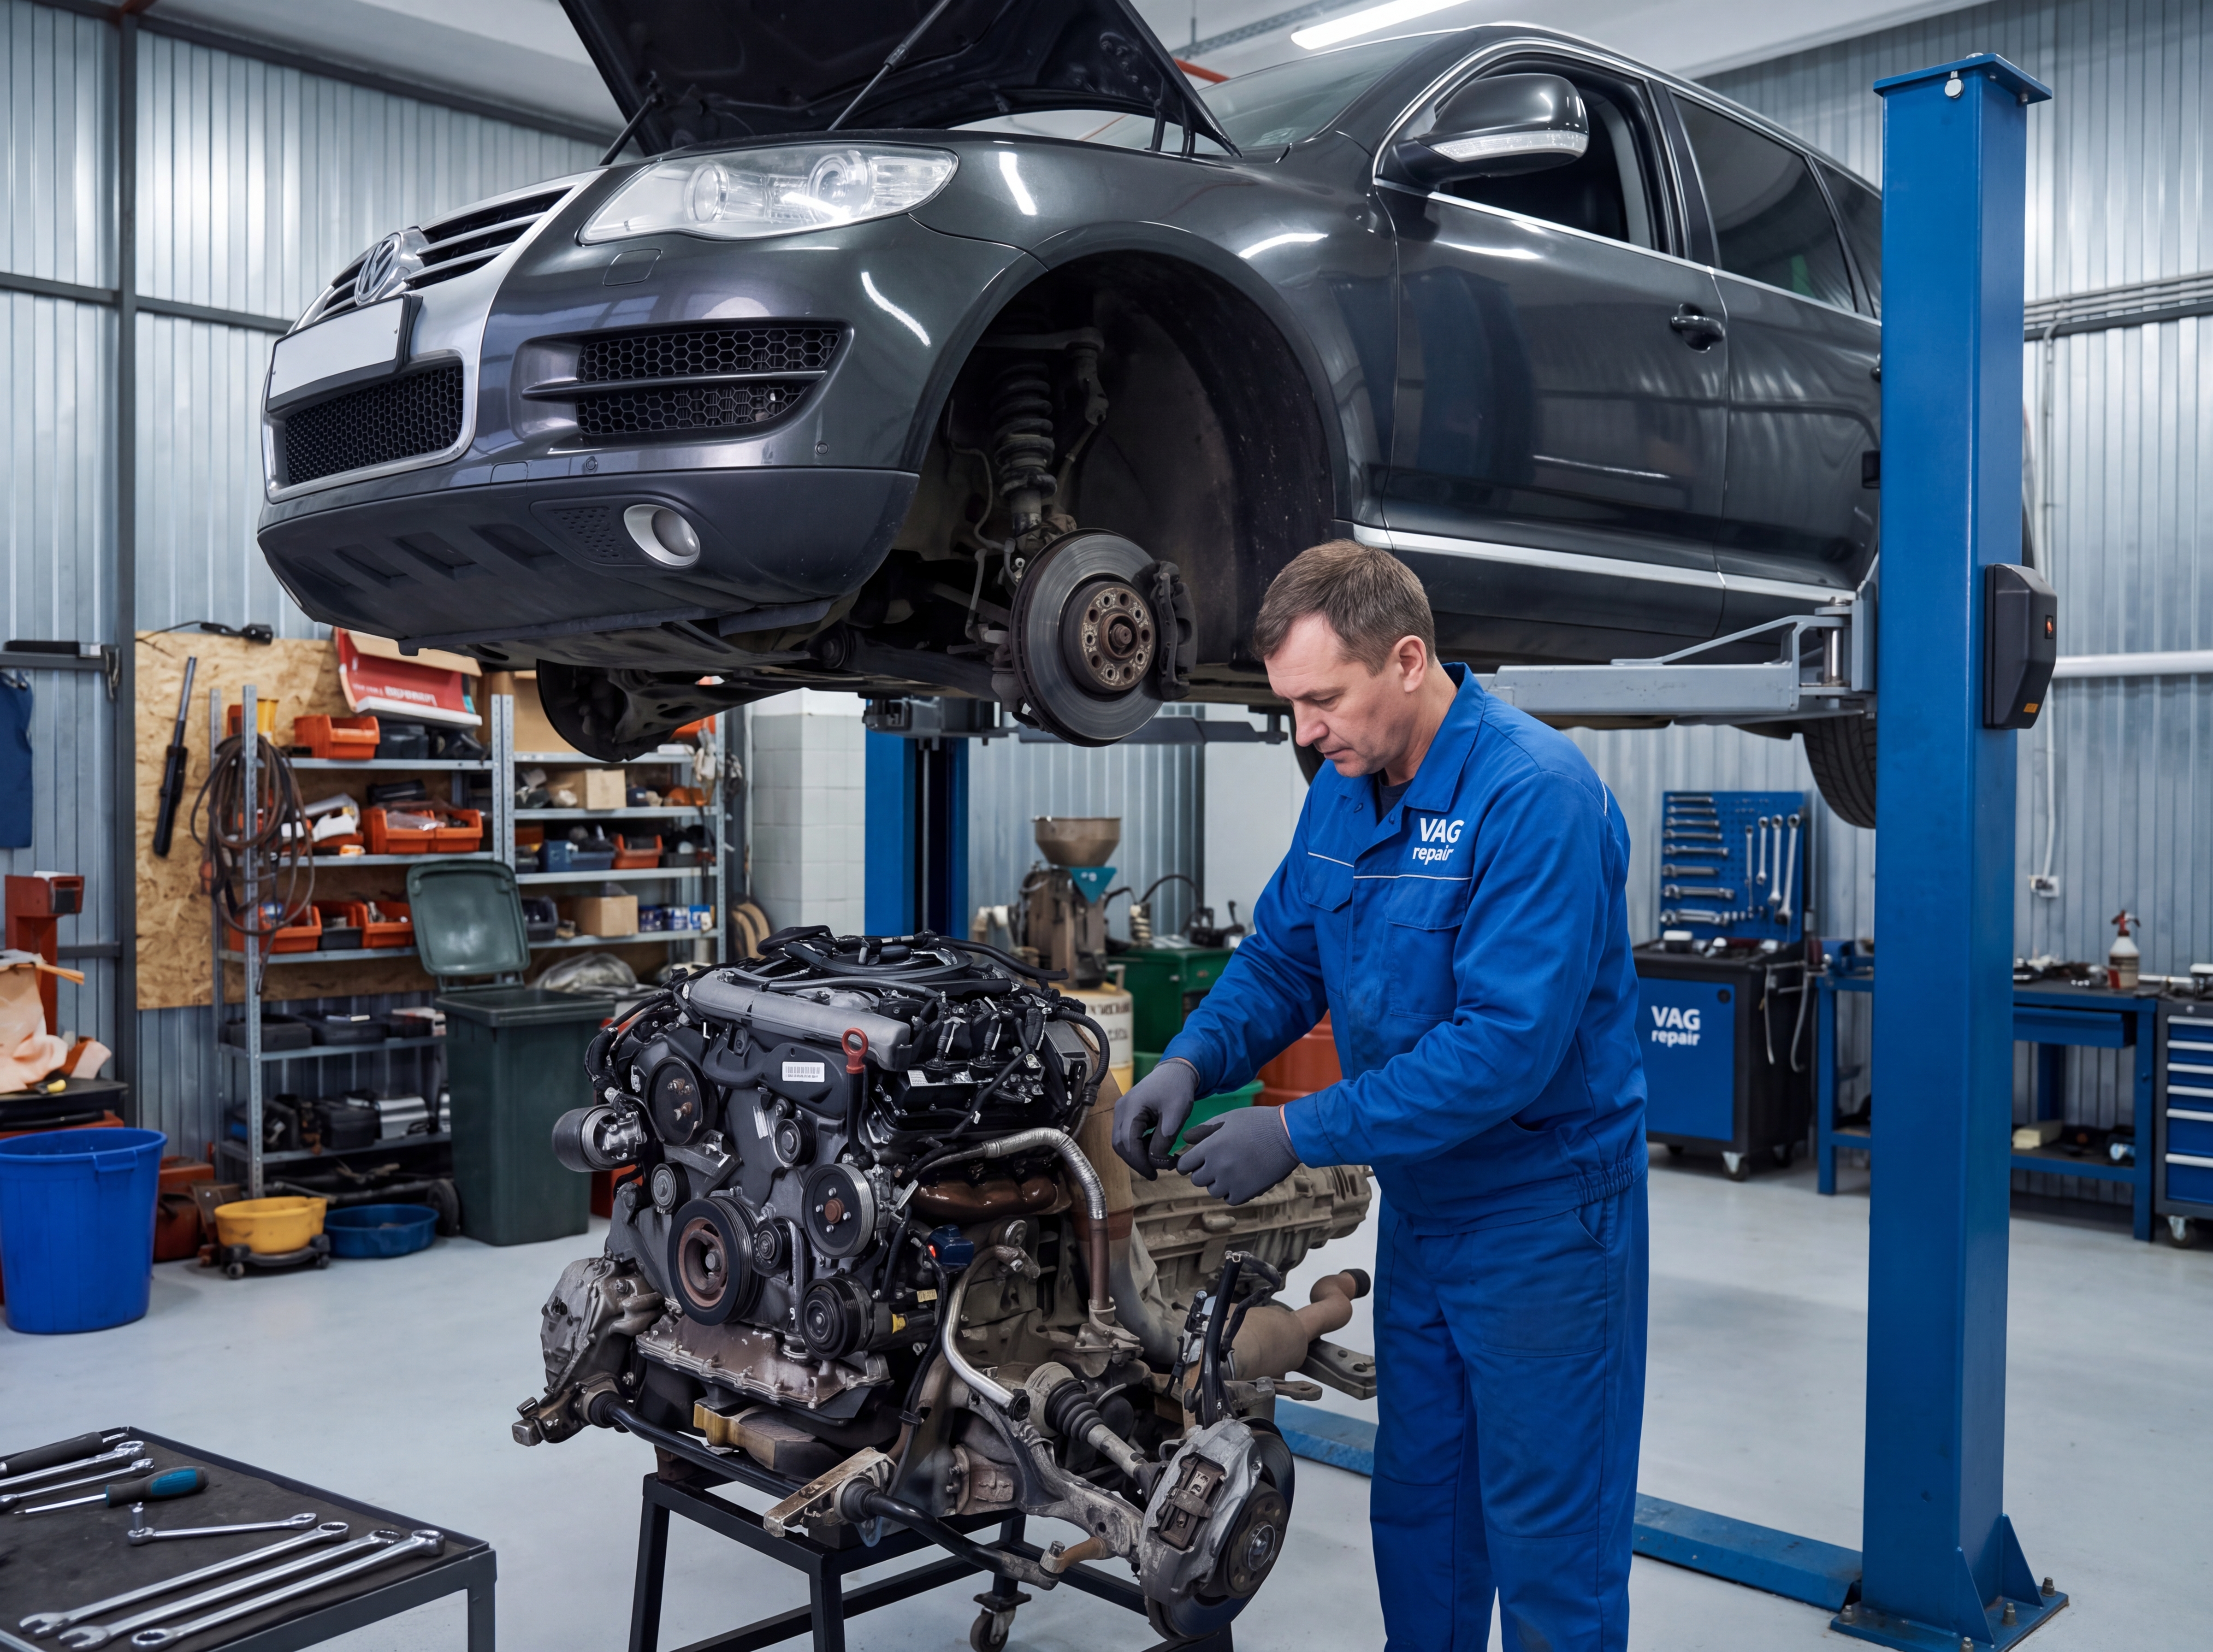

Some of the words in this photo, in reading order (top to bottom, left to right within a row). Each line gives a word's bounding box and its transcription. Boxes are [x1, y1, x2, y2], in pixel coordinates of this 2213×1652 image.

[1420, 818, 1465, 843] VAG
[1412, 844, 1454, 865] repair
[1651, 1005, 1701, 1031] VAG
[1651, 1030, 1700, 1048] repair
